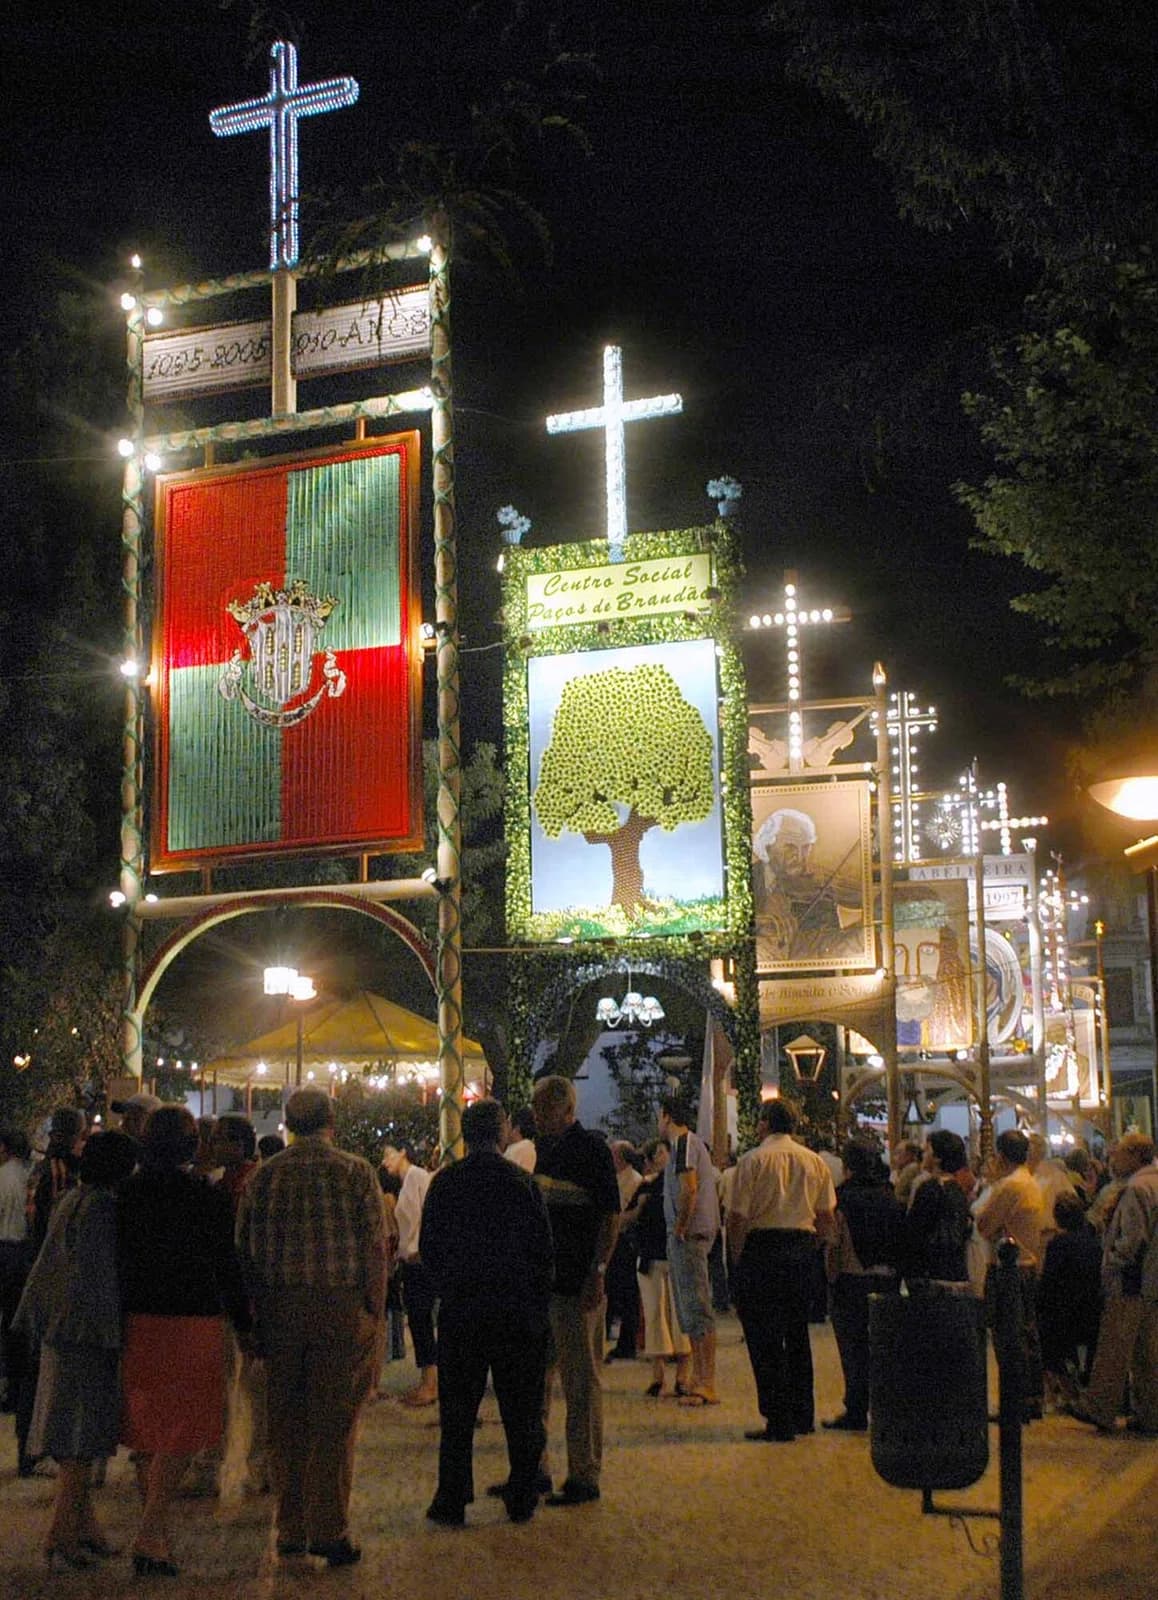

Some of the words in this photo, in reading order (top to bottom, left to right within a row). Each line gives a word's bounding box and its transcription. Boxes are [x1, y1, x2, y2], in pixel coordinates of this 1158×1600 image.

[543, 574, 615, 597] Centro
[622, 561, 693, 587] Social
[528, 602, 587, 623] Paços
[592, 599, 612, 613] de
